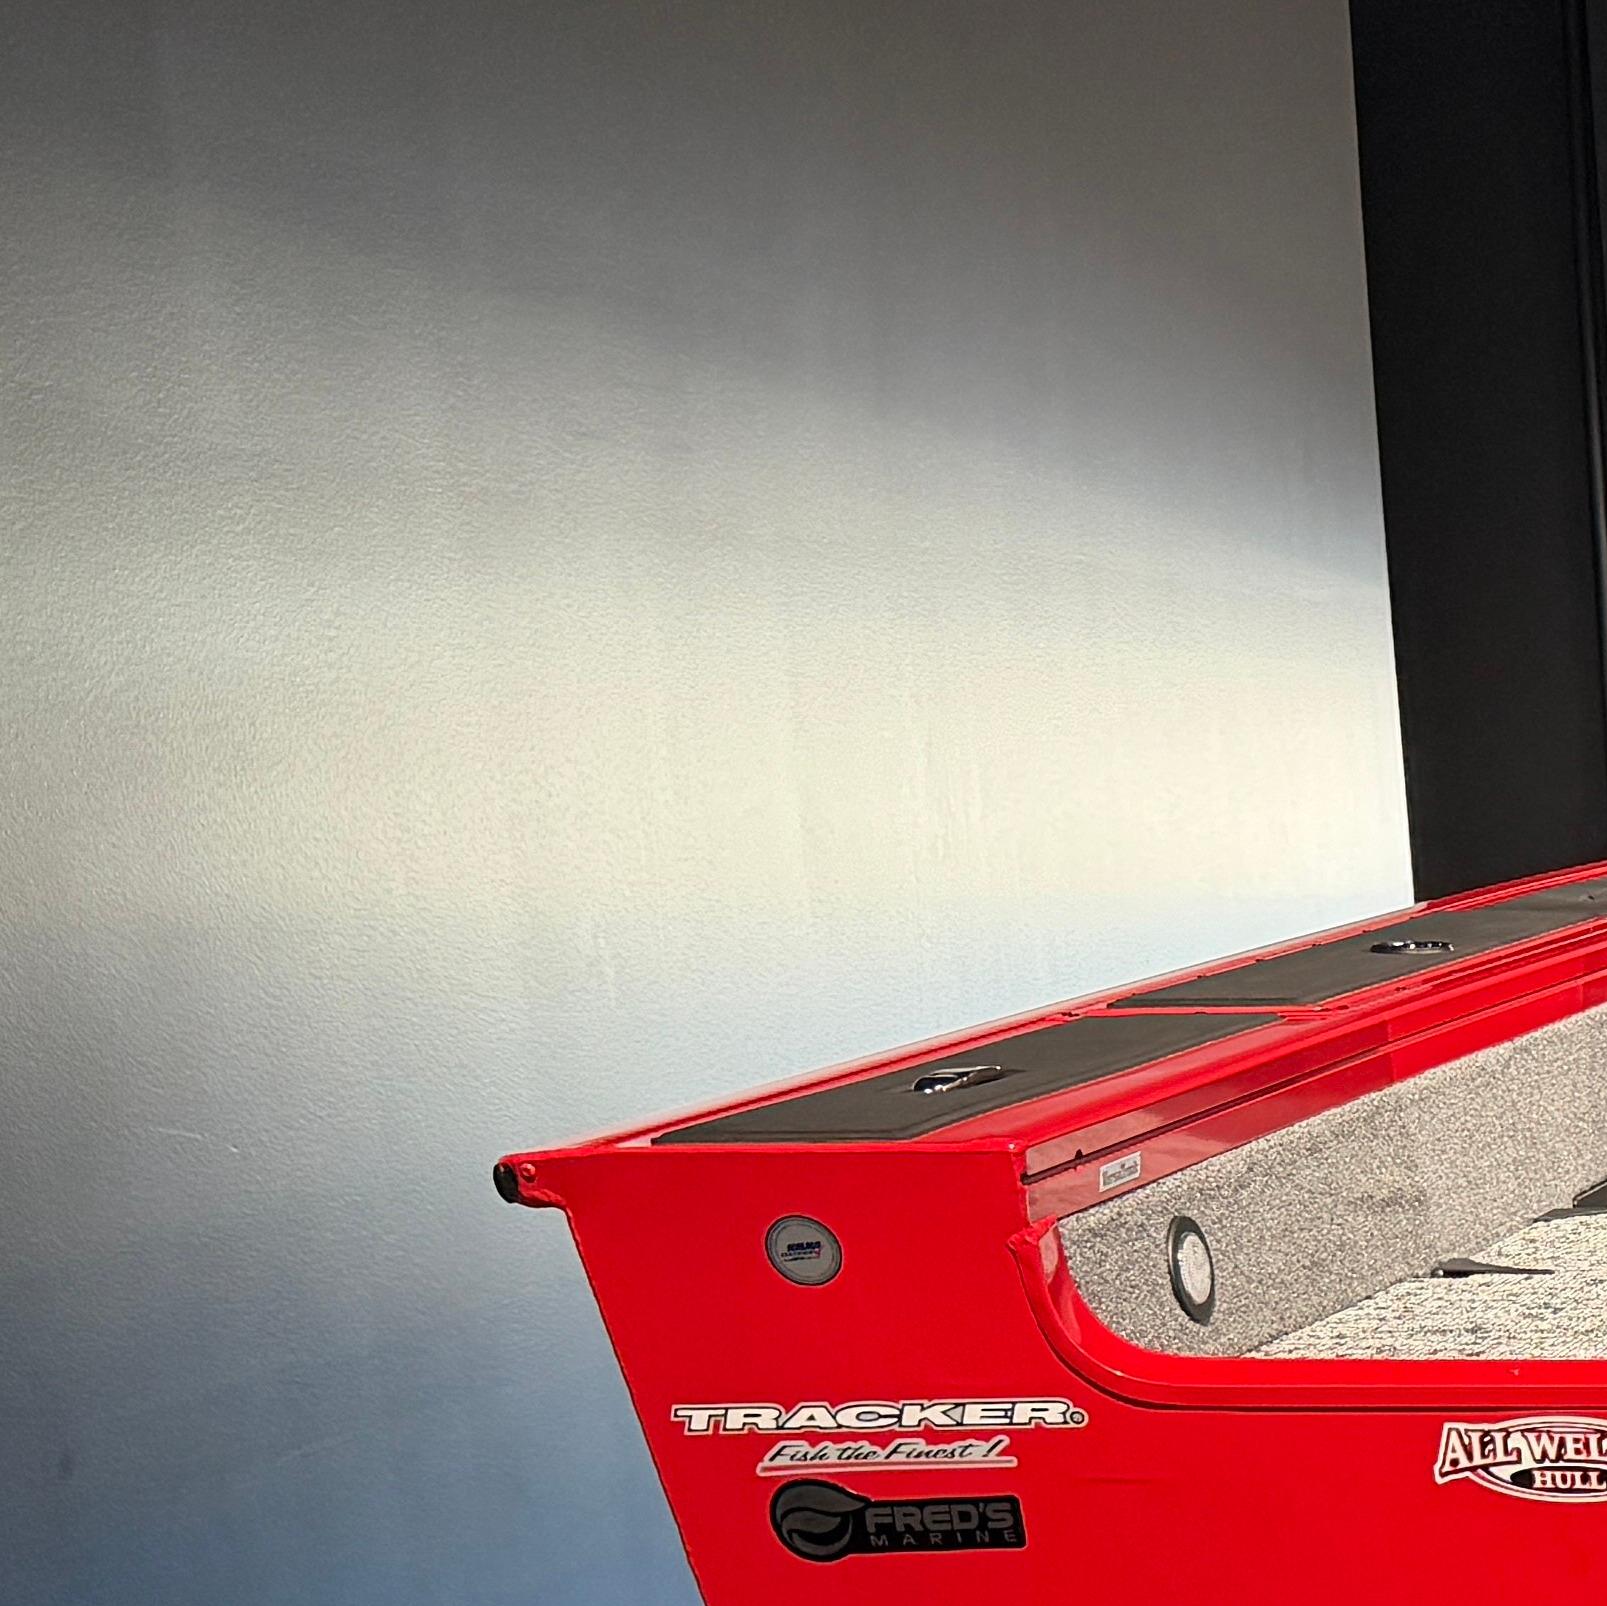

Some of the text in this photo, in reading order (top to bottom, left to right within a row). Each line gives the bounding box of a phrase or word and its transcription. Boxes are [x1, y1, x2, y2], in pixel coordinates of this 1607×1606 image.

[1531, 1469, 1607, 1491] HULL
[865, 1499, 1014, 1533] FRED'S
[870, 1528, 1018, 1548] MARINE
